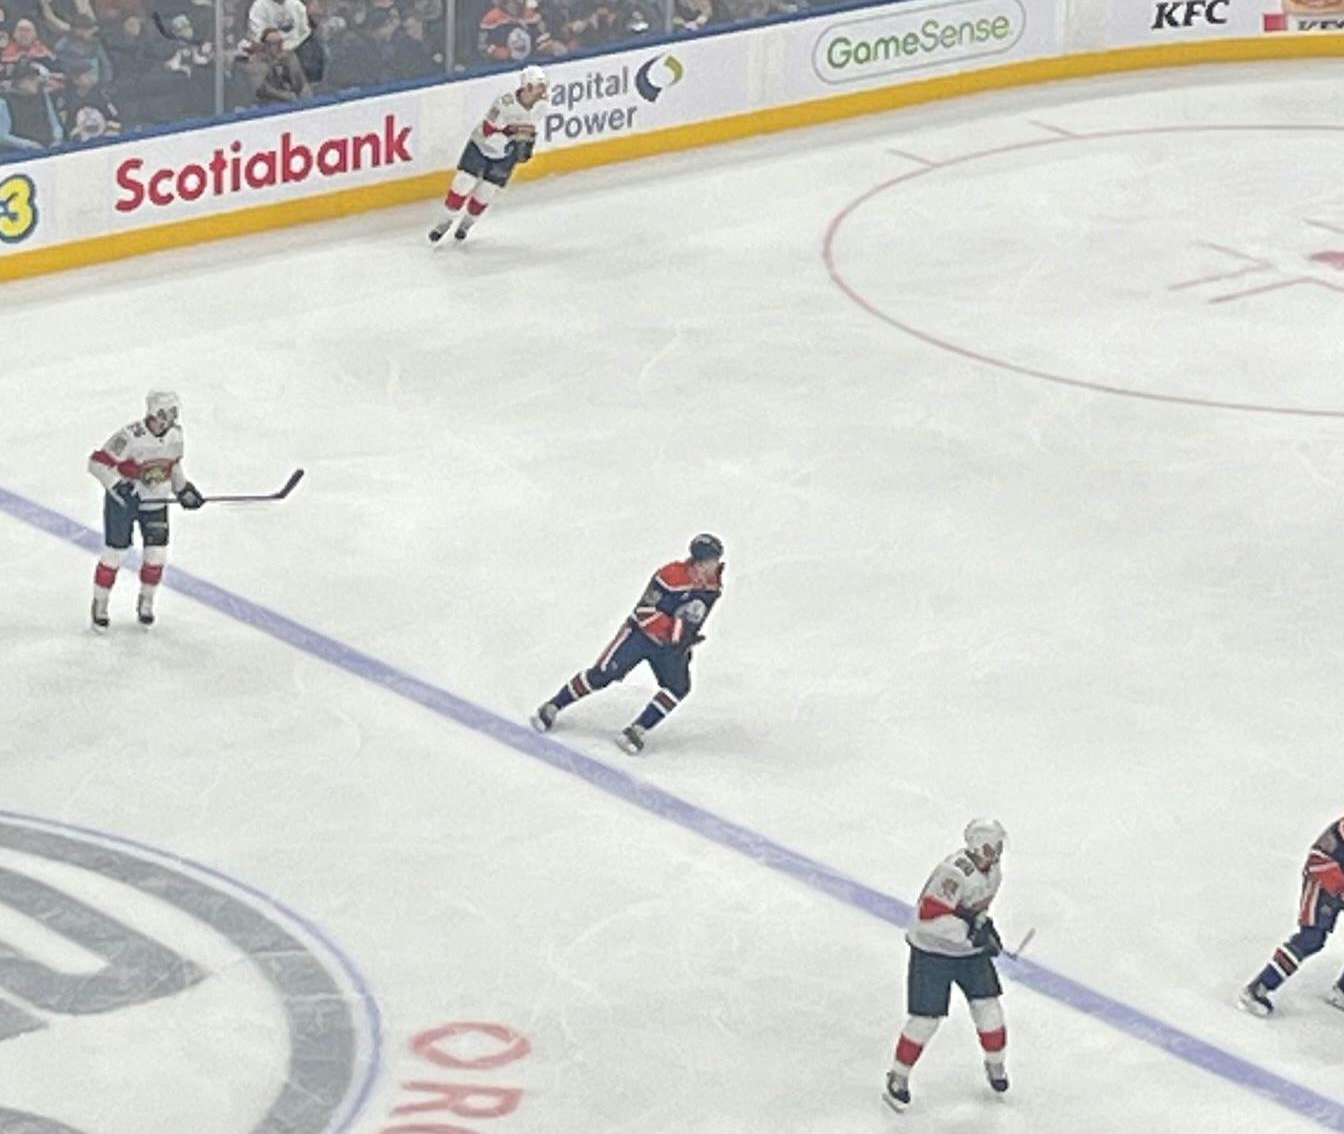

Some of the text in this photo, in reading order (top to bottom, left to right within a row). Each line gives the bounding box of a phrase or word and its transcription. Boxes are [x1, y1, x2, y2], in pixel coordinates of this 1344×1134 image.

[826, 14, 1011, 70] GameSense
[550, 65, 628, 111] apital
[544, 106, 637, 142] Power
[114, 114, 414, 213] Scotiabank
